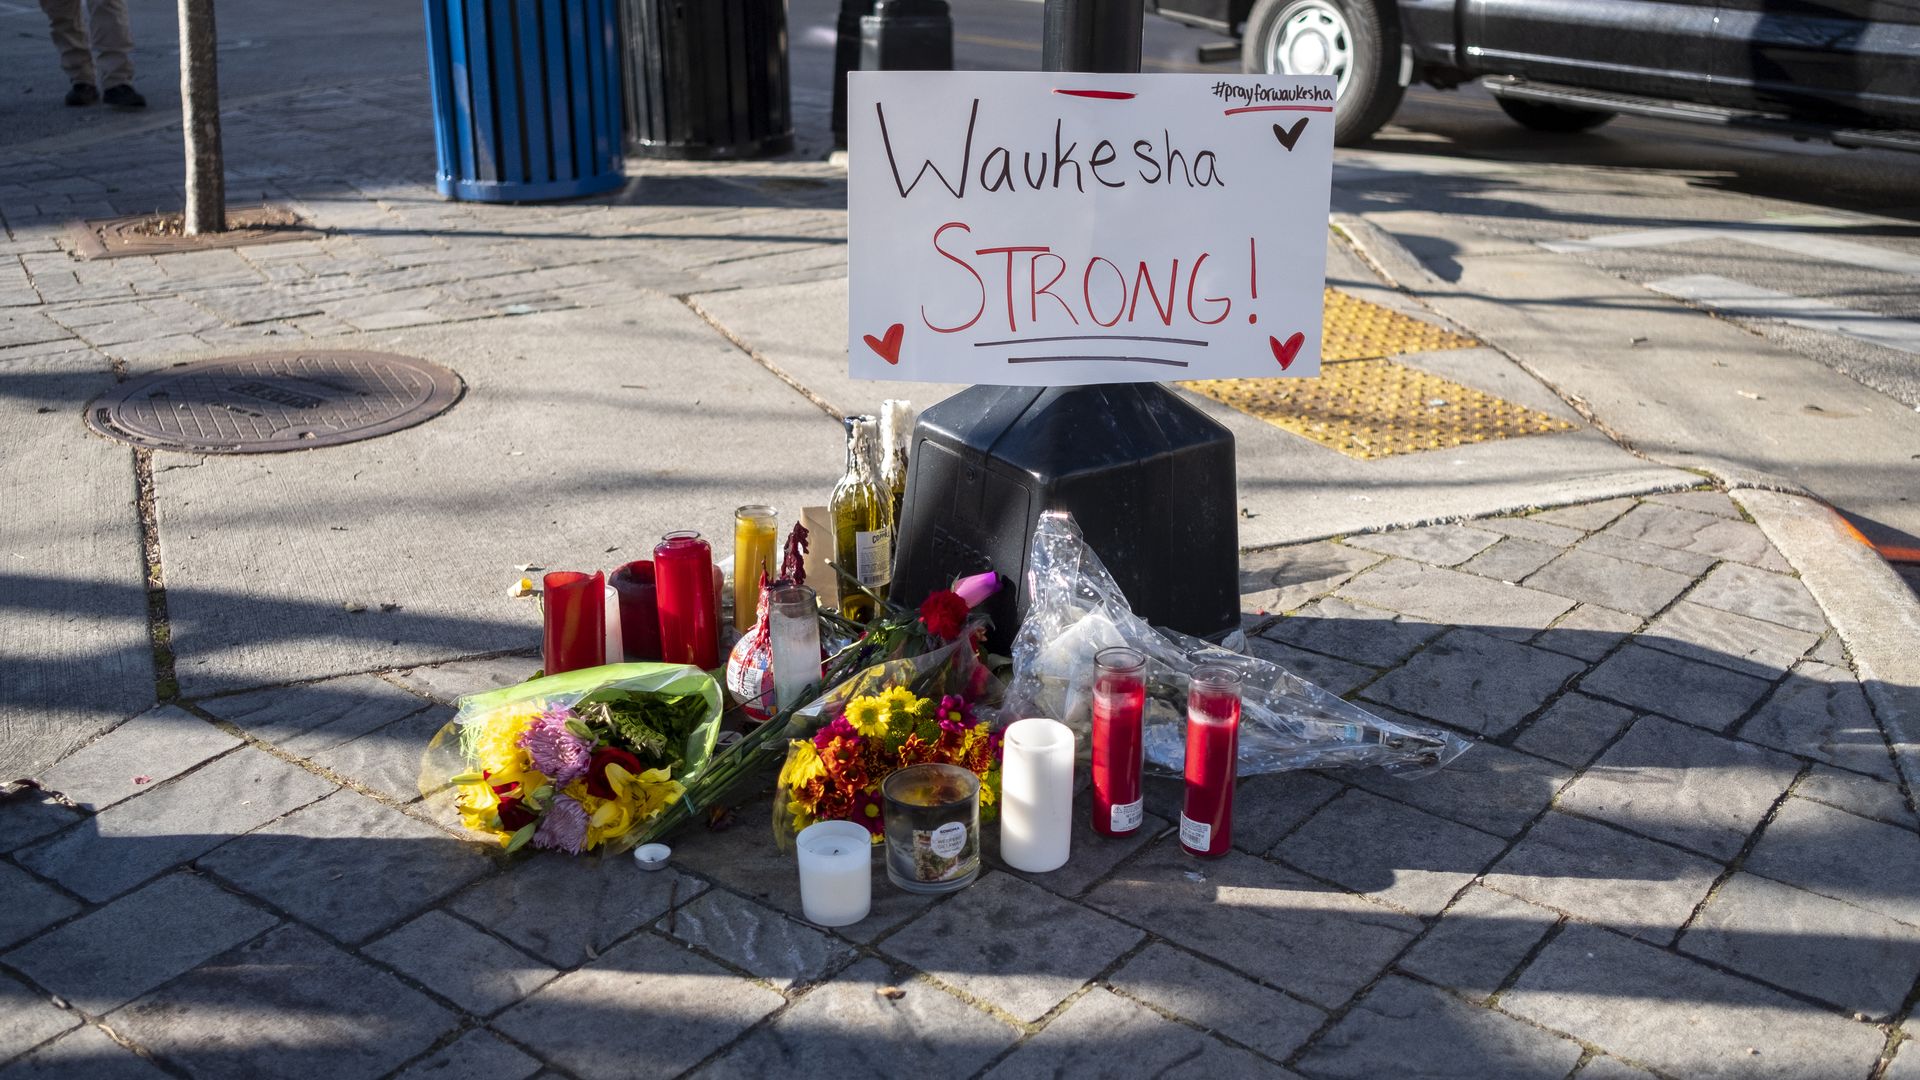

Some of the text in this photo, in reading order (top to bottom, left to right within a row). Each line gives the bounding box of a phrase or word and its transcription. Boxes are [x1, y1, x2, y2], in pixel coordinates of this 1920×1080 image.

[1211, 81, 1333, 107] #prayforwaukesha
[876, 98, 1225, 199] Waukesha
[920, 221, 1258, 334] STRONG!
